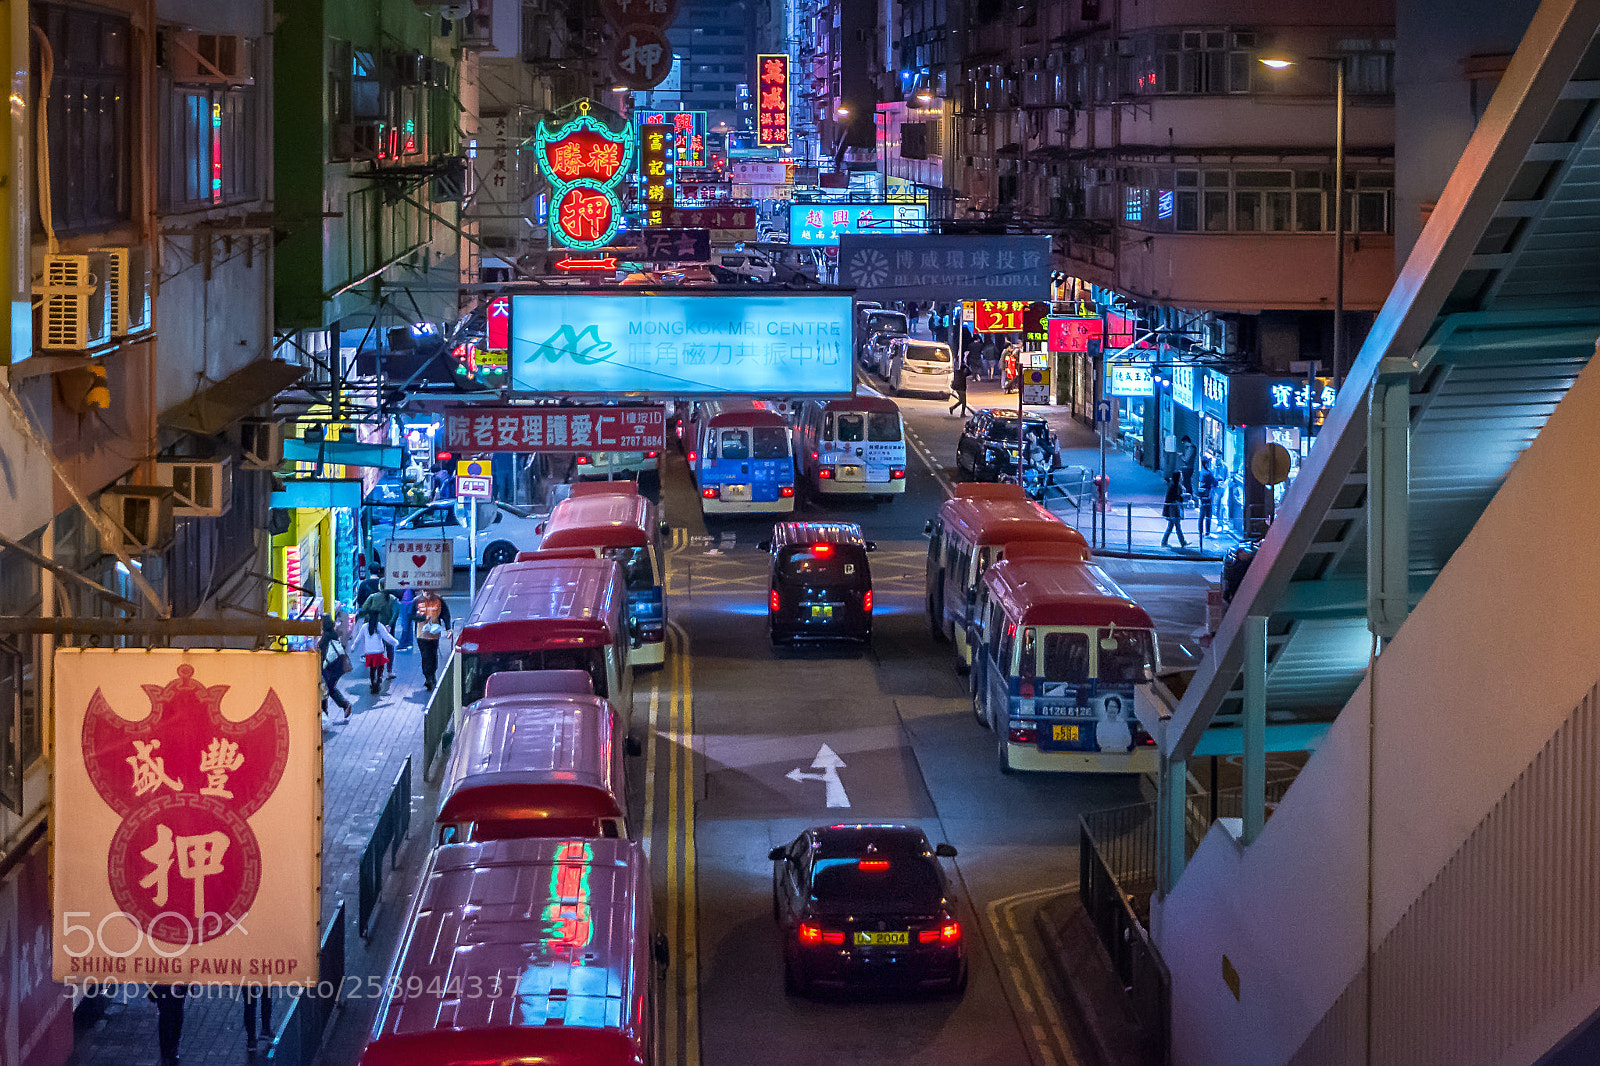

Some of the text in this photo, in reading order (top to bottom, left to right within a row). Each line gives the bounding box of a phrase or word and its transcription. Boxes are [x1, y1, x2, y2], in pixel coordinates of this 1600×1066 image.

[619, 35, 662, 79] 押
[648, 132, 666, 226] 富記粥品
[562, 190, 609, 239] 押
[894, 274, 1041, 286] BLACKWELL GLOBAL
[628, 321, 841, 336] MONGKOK MRI CENTRE
[988, 312, 1017, 329] 21
[628, 340, 841, 367] 旺角磁力共振中心
[126, 737, 245, 799] 盛豐
[139, 824, 230, 919] 押
[876, 933, 905, 943] 2004
[70, 957, 298, 975] SHING FUNG PAWN SHOP
